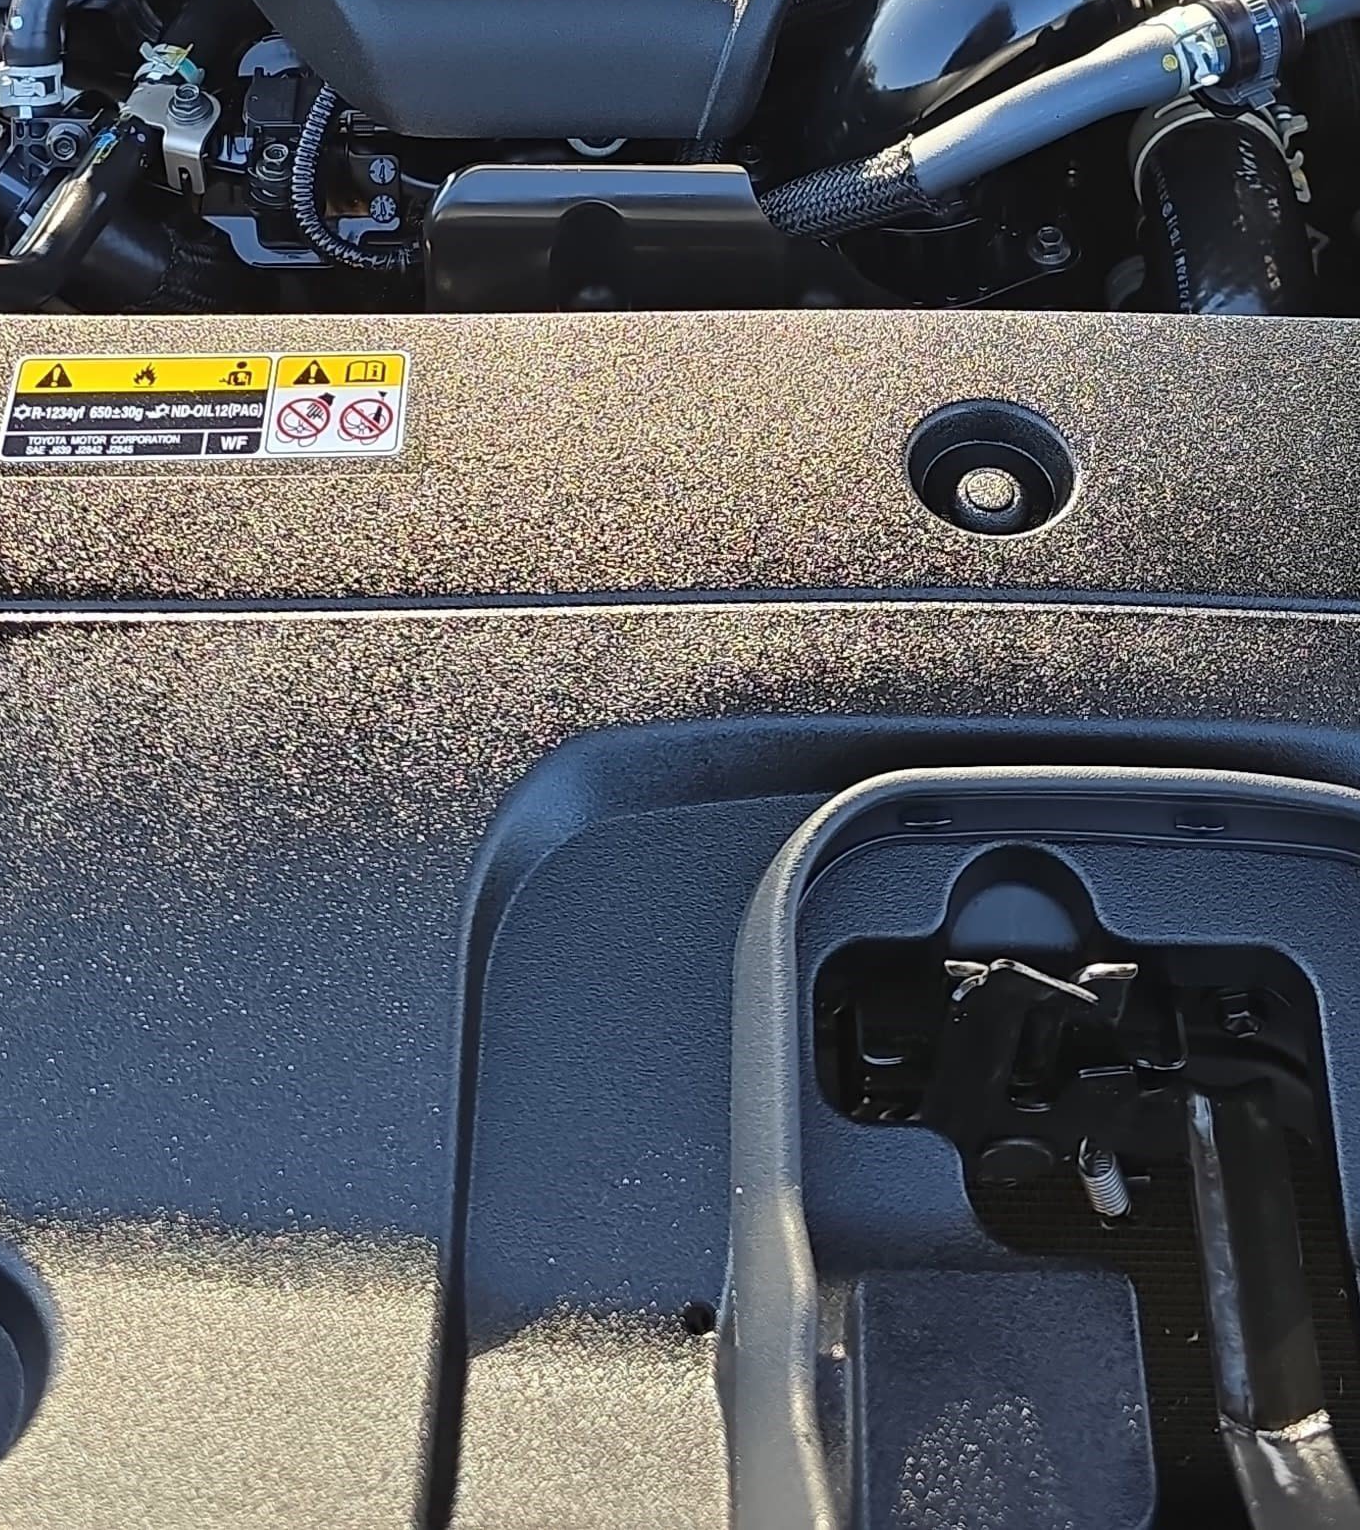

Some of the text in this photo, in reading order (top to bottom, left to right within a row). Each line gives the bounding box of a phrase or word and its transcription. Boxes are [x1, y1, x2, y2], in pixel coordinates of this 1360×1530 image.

[31, 402, 264, 422] R-1234yf 650±30g ND-OIL12(PAG)
[27, 434, 181, 446] TOYOTA MOTOR CORPORATION
[220, 435, 249, 451] WF
[25, 445, 46, 455] SAE
